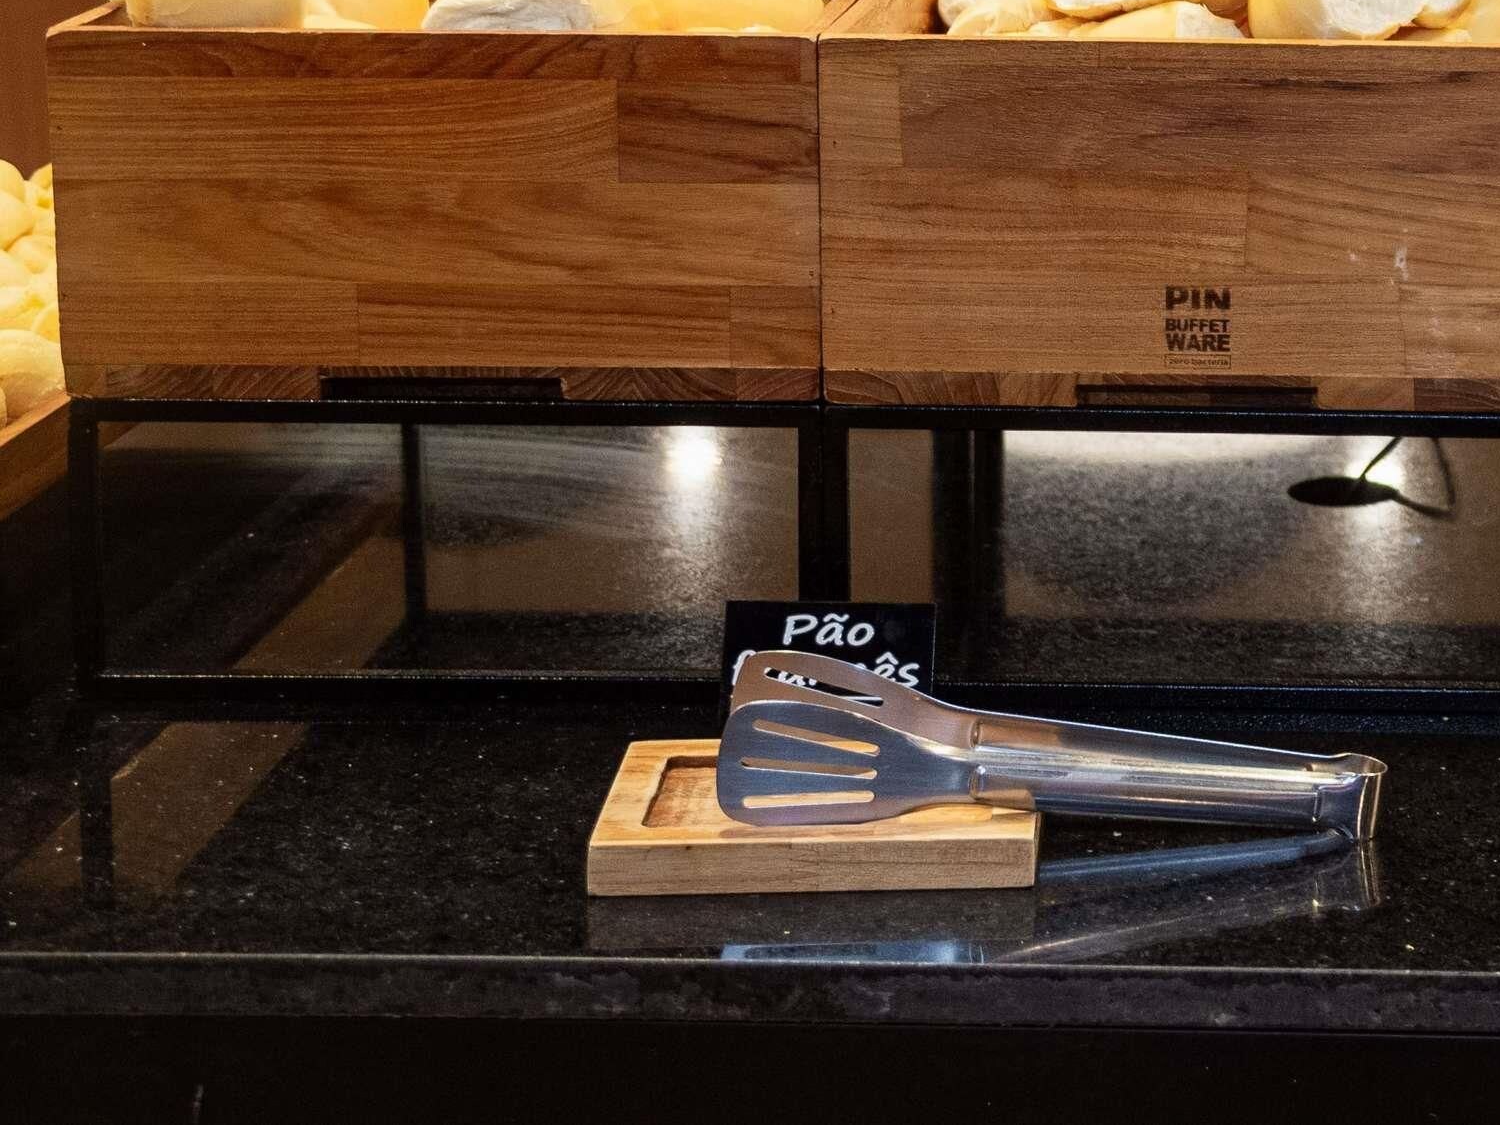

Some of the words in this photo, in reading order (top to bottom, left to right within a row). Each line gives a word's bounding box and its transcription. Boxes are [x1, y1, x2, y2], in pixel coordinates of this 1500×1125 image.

[1166, 286, 1231, 310] PIN
[1165, 318, 1230, 333] BUFFET
[1165, 333, 1230, 352] WARE
[782, 613, 875, 647] Pão
